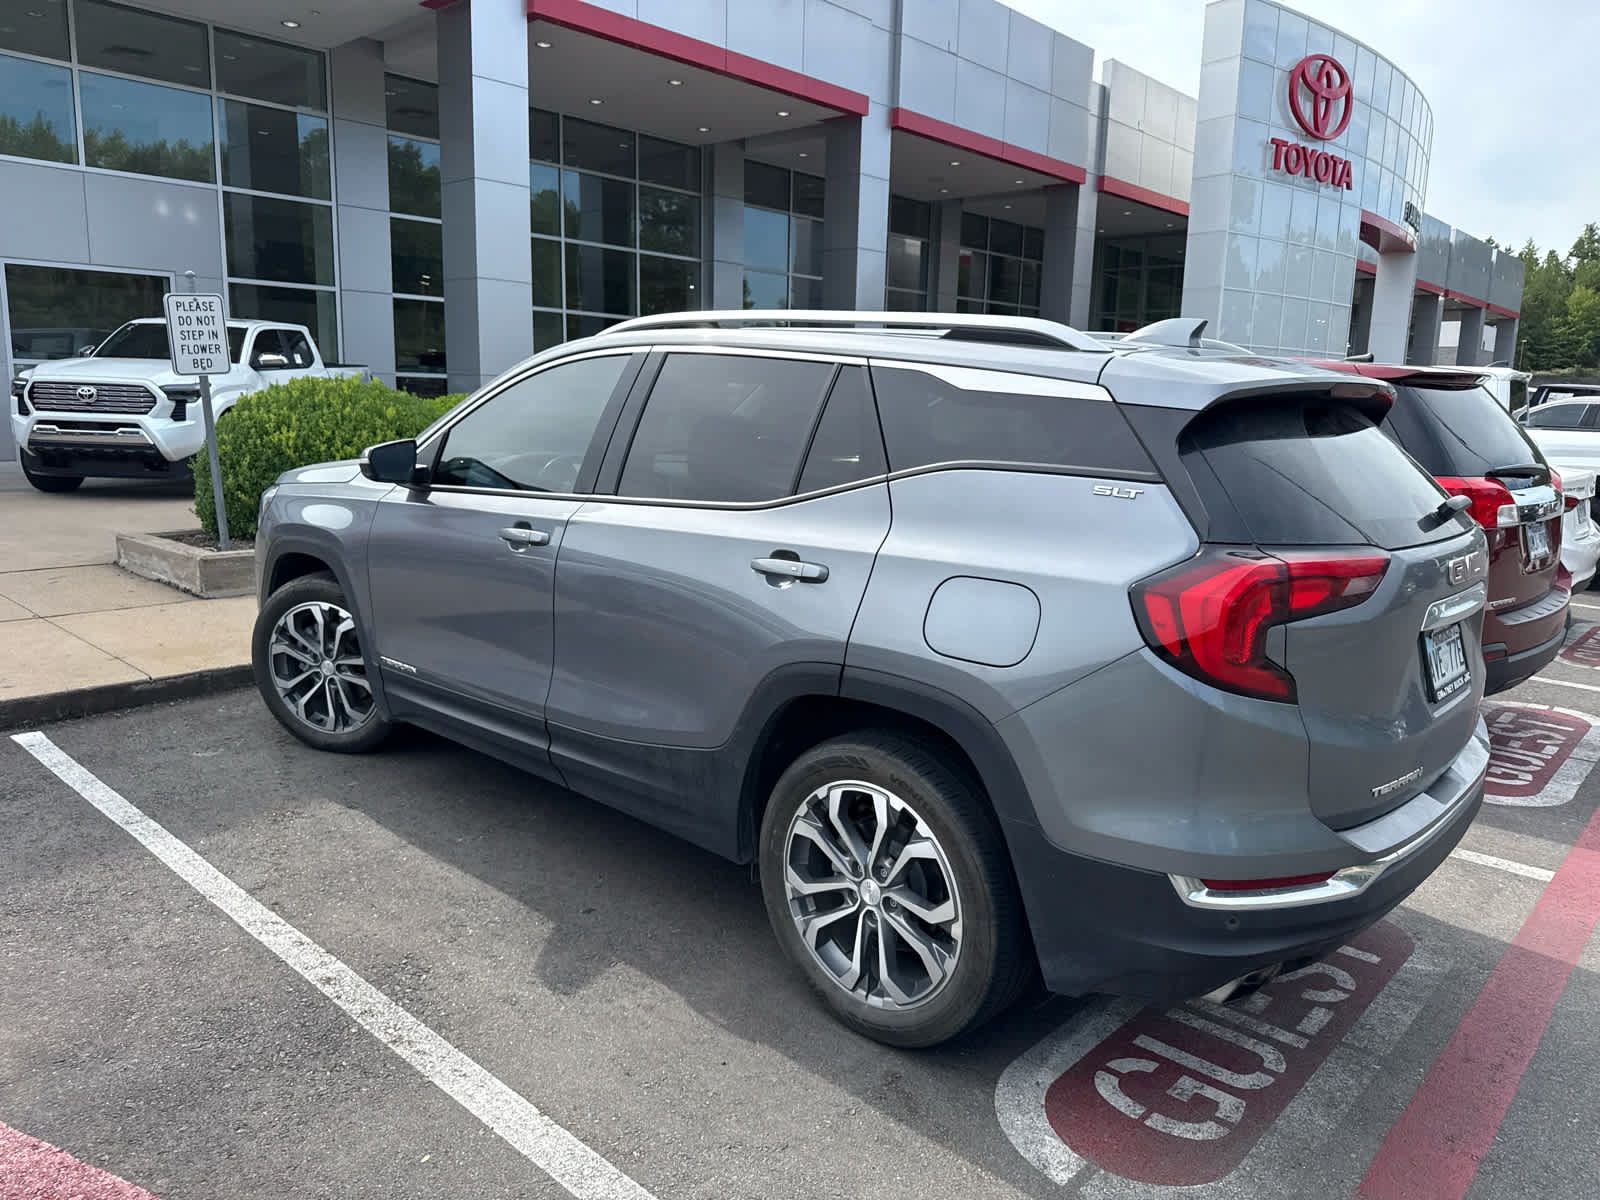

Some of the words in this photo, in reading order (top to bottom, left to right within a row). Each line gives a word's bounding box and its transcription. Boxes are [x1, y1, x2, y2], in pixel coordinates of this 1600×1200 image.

[1270, 137, 1353, 191] TOYOTA
[175, 301, 215, 312] PLEASE
[177, 315, 193, 326] DO
[196, 315, 215, 326] NOT
[179, 330, 205, 341] STEP
[207, 330, 219, 340] IN
[180, 344, 222, 355] FLOWER
[192, 358, 213, 369] BED
[1092, 485, 1145, 500] SLT
